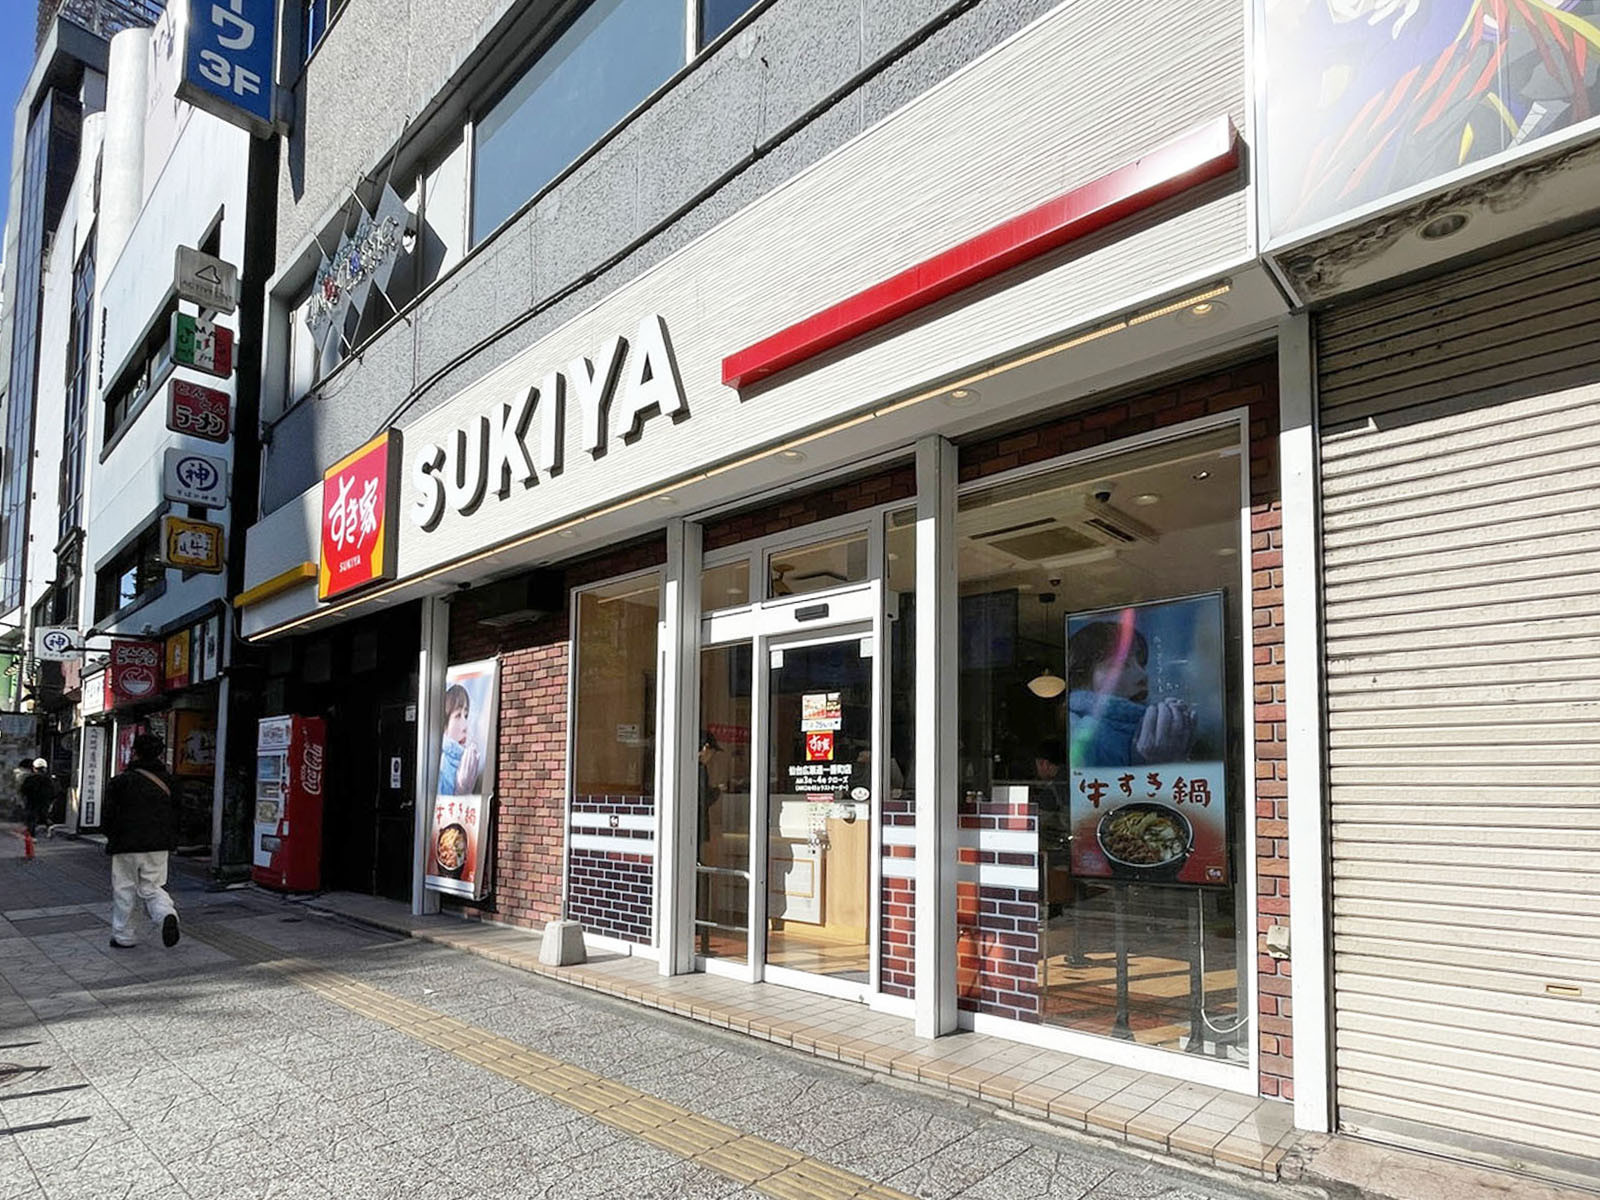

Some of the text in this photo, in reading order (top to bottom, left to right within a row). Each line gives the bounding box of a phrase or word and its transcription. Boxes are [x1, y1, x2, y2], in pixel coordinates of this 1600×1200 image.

[199, 49, 261, 96] 3F
[410, 313, 691, 533] SUKIYA
[185, 462, 210, 486] 神
[328, 475, 379, 551] すき家
[339, 555, 361, 573] SUKIYA
[1079, 772, 1212, 808] 牛すき鍋
